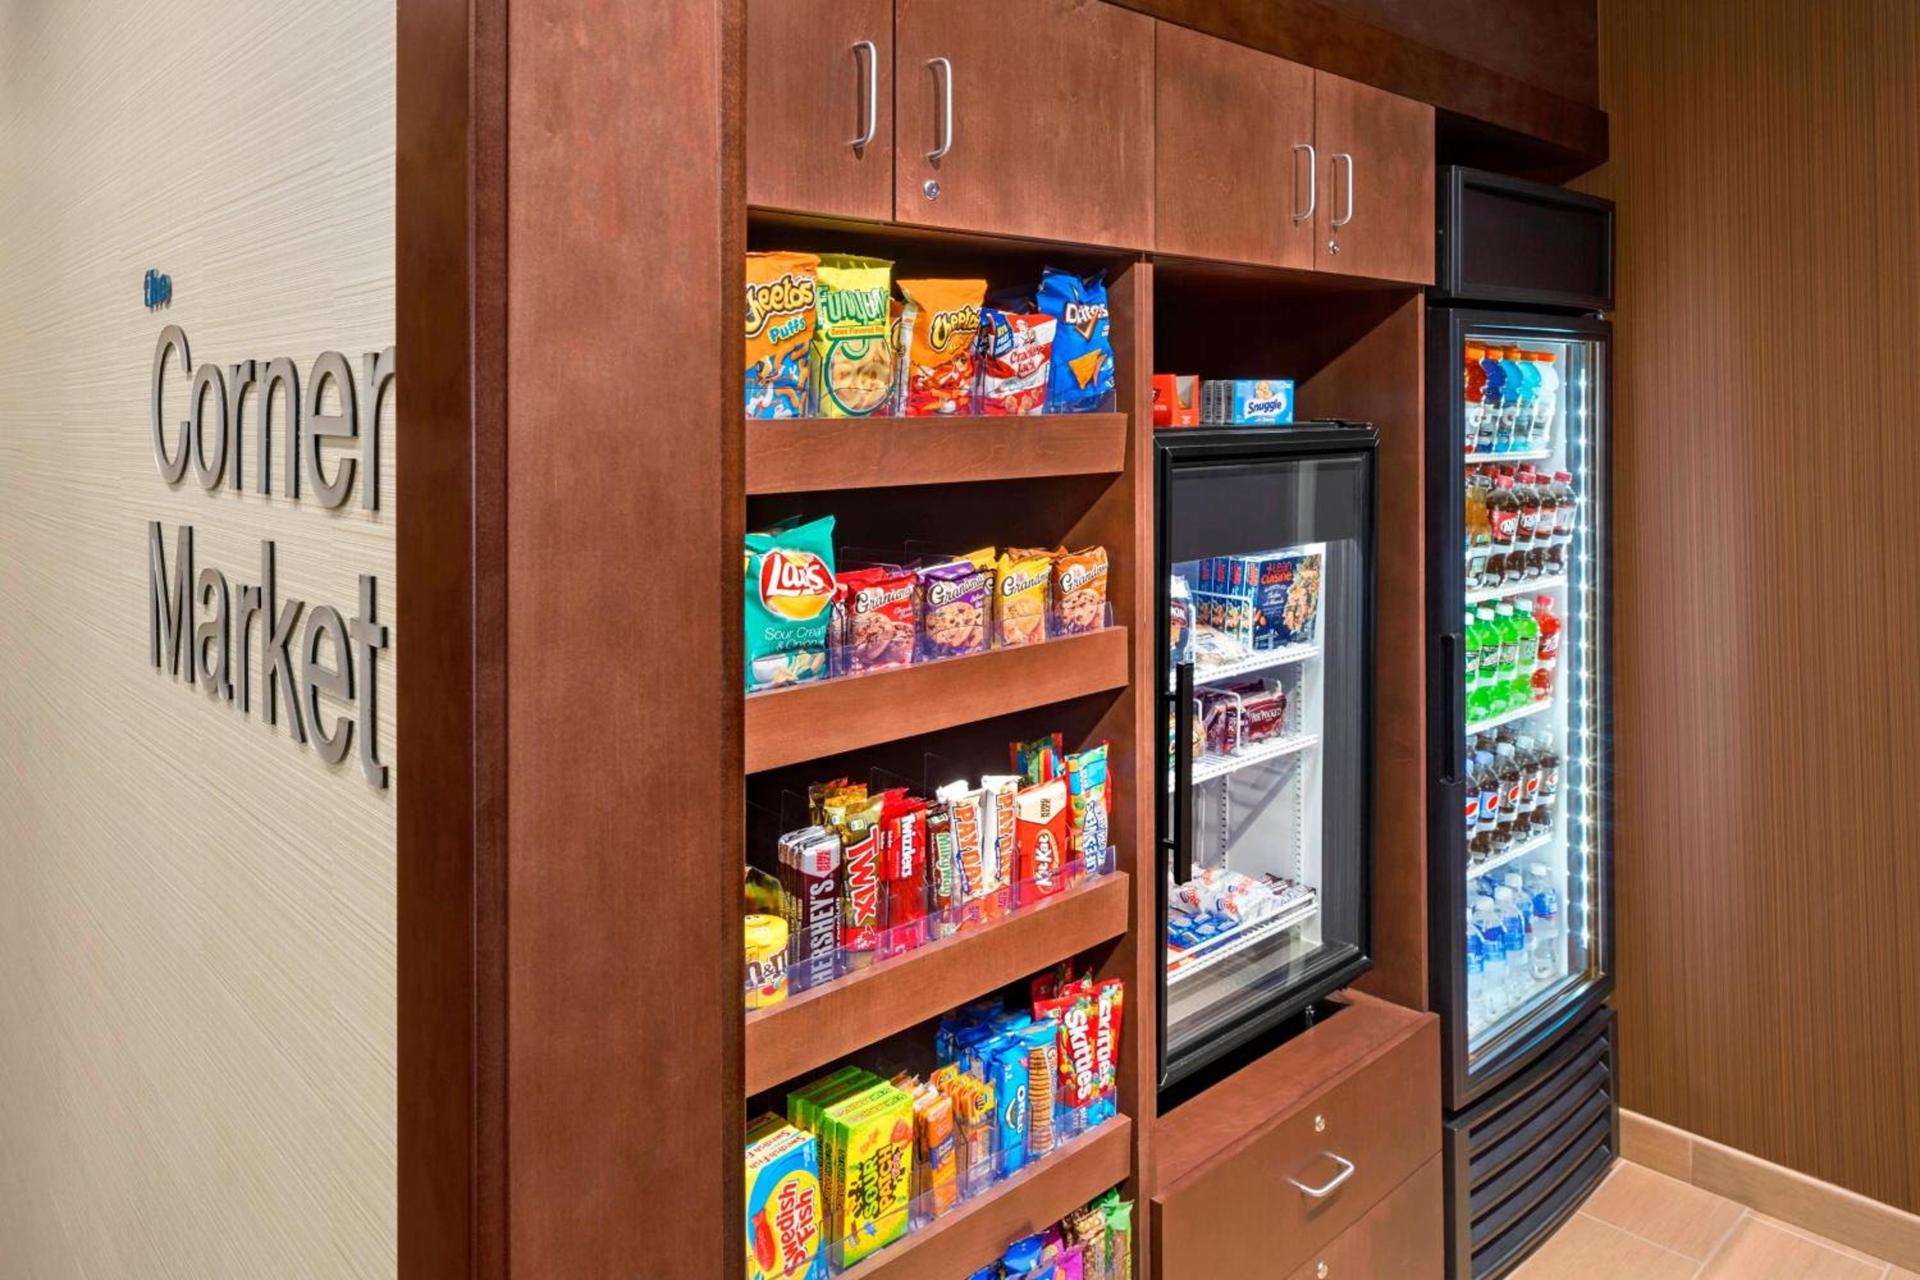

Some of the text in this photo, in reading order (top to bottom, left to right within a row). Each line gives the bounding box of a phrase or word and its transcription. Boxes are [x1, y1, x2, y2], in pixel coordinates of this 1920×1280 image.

[768, 316, 806, 344] Puffs
[150, 324, 396, 512] Corner
[1248, 399, 1282, 414] Snuggle
[147, 520, 389, 790] Market
[764, 627, 794, 641] Sour
[847, 825, 880, 927] TWIX
[955, 805, 983, 895] PAYDAY
[1035, 833, 1052, 862] Kat
[810, 878, 835, 987] HERSHEY'S
[1064, 1009, 1093, 1099] Skittles
[795, 1185, 816, 1246] Fish
[862, 1156, 880, 1219] SOUR
[877, 1145, 896, 1212] PATCH
[776, 1178, 808, 1277] Swedish
